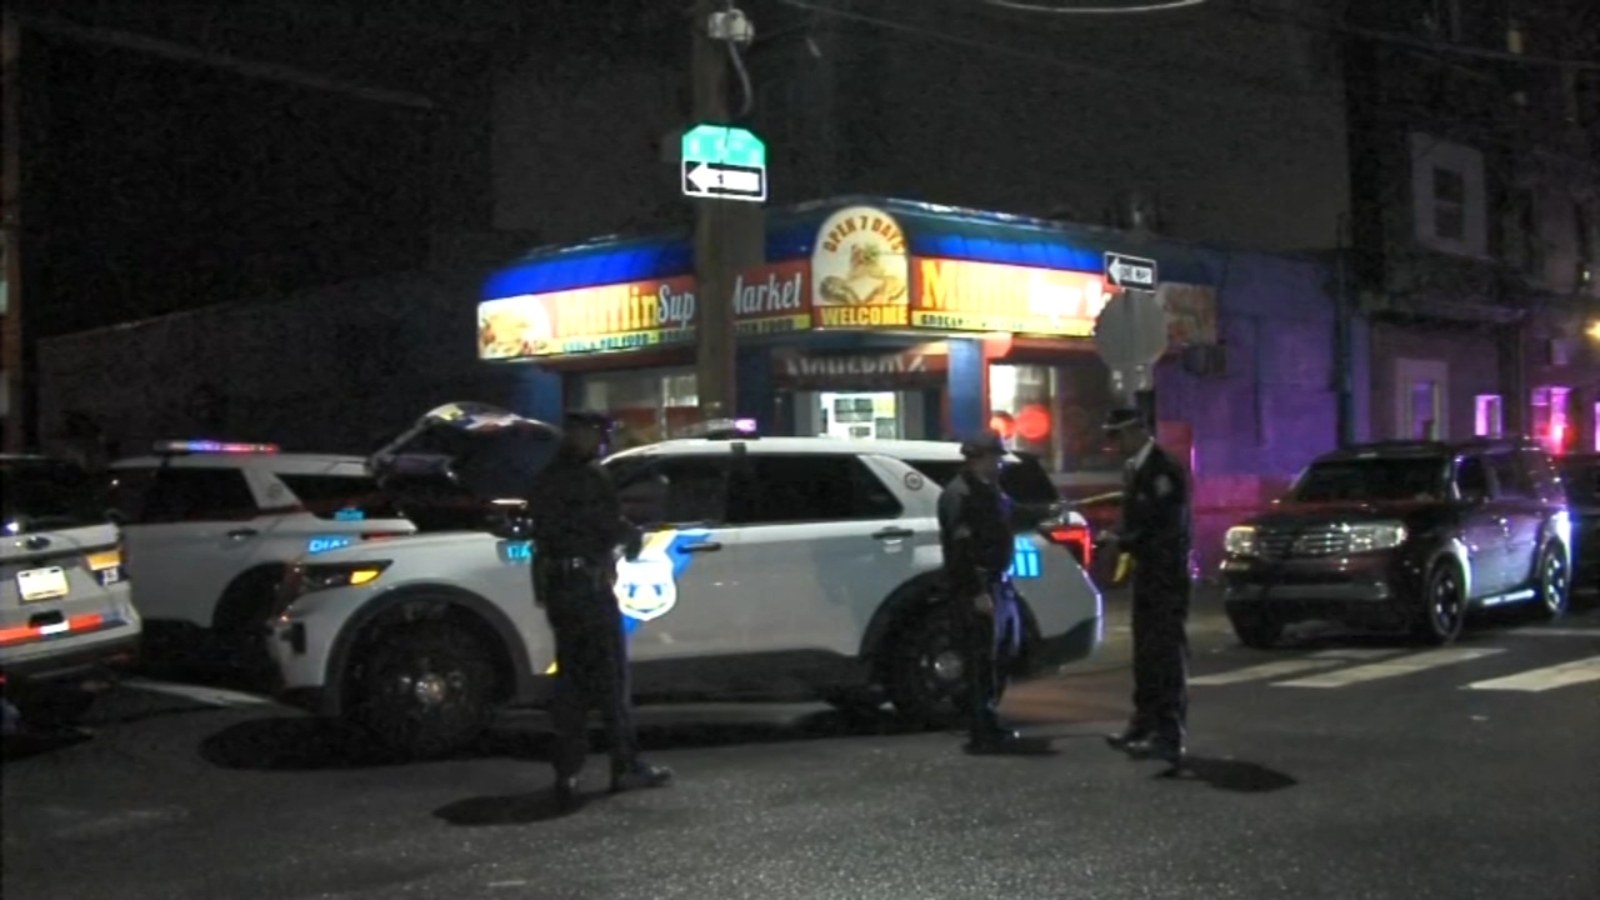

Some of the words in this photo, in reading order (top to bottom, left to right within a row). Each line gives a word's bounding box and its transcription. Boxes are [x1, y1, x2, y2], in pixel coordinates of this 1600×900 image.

[859, 215, 869, 231] 7
[656, 284, 696, 330] Sup
[822, 306, 908, 326] WELCOME
[1008, 551, 1039, 577] 11
